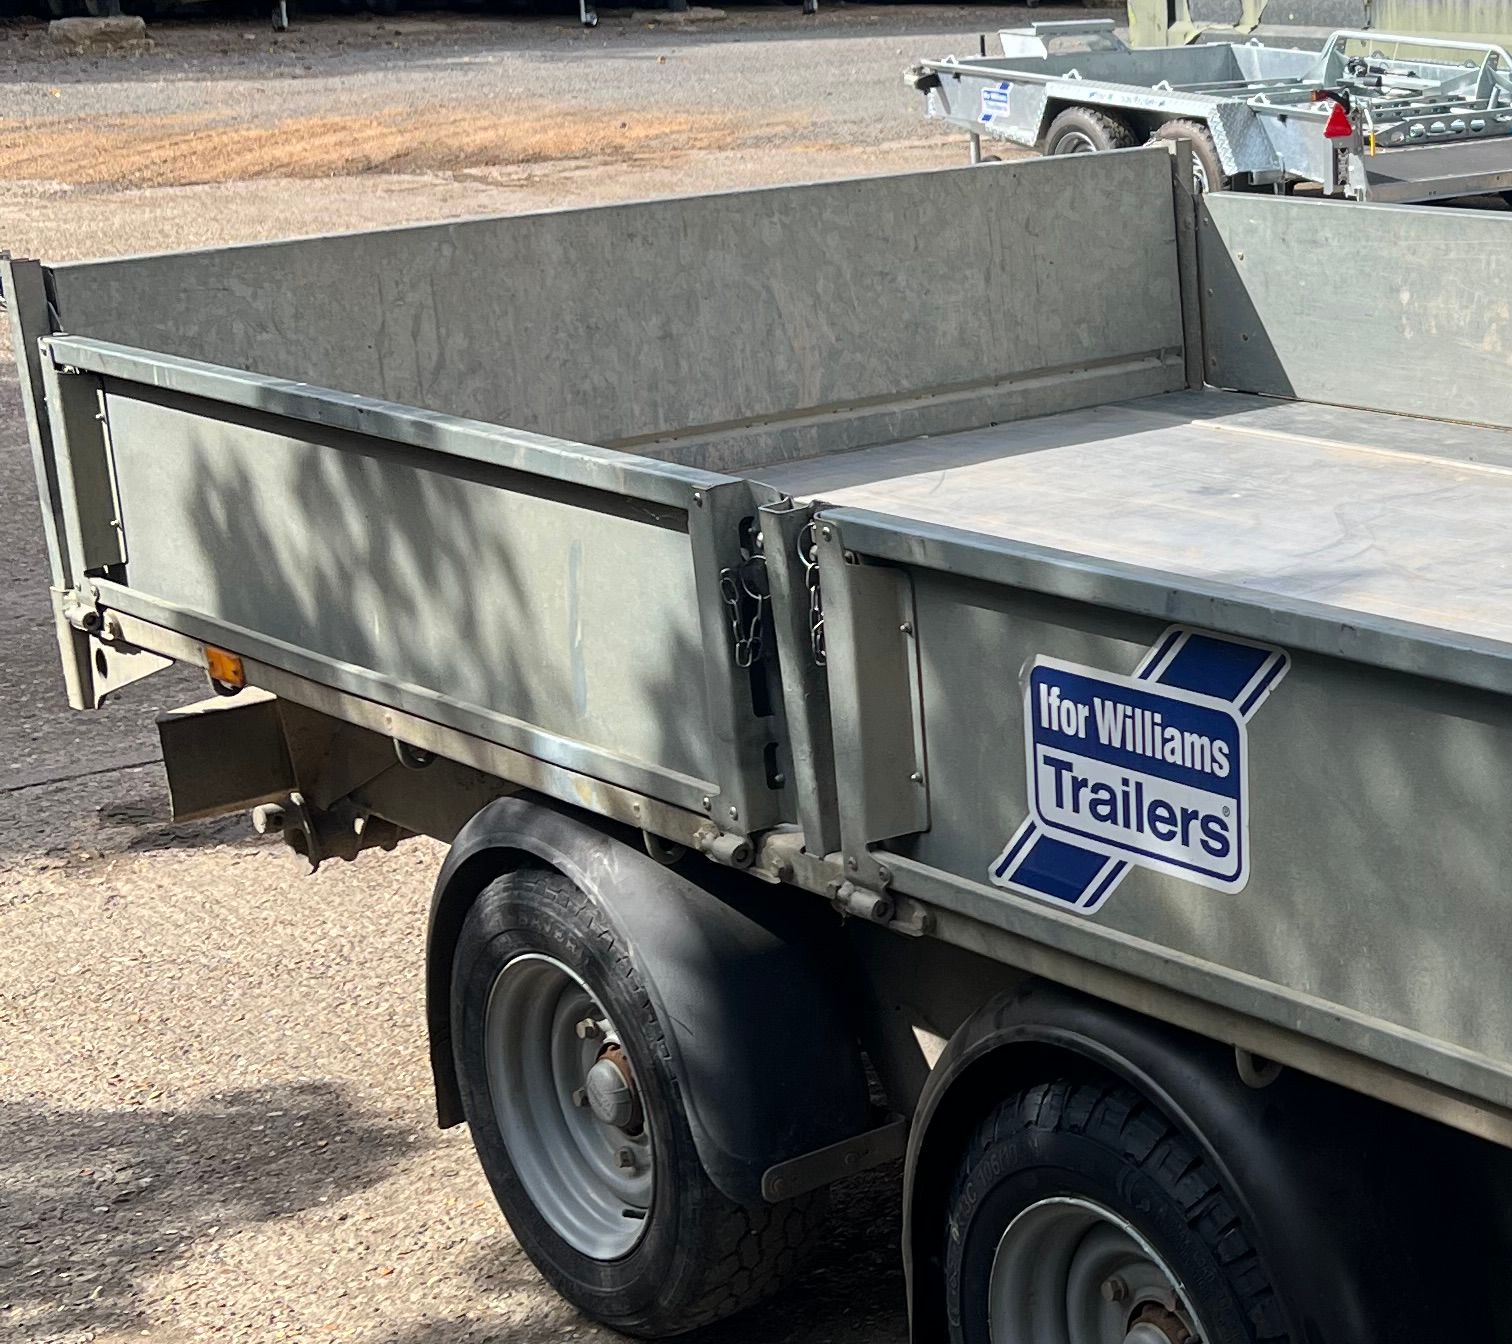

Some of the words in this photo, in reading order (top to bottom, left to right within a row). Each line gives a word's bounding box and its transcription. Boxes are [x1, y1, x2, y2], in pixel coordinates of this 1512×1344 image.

[1039, 682, 1090, 739] Ifor
[1093, 696, 1230, 778] Williams
[1042, 754, 1231, 858] Trailers
